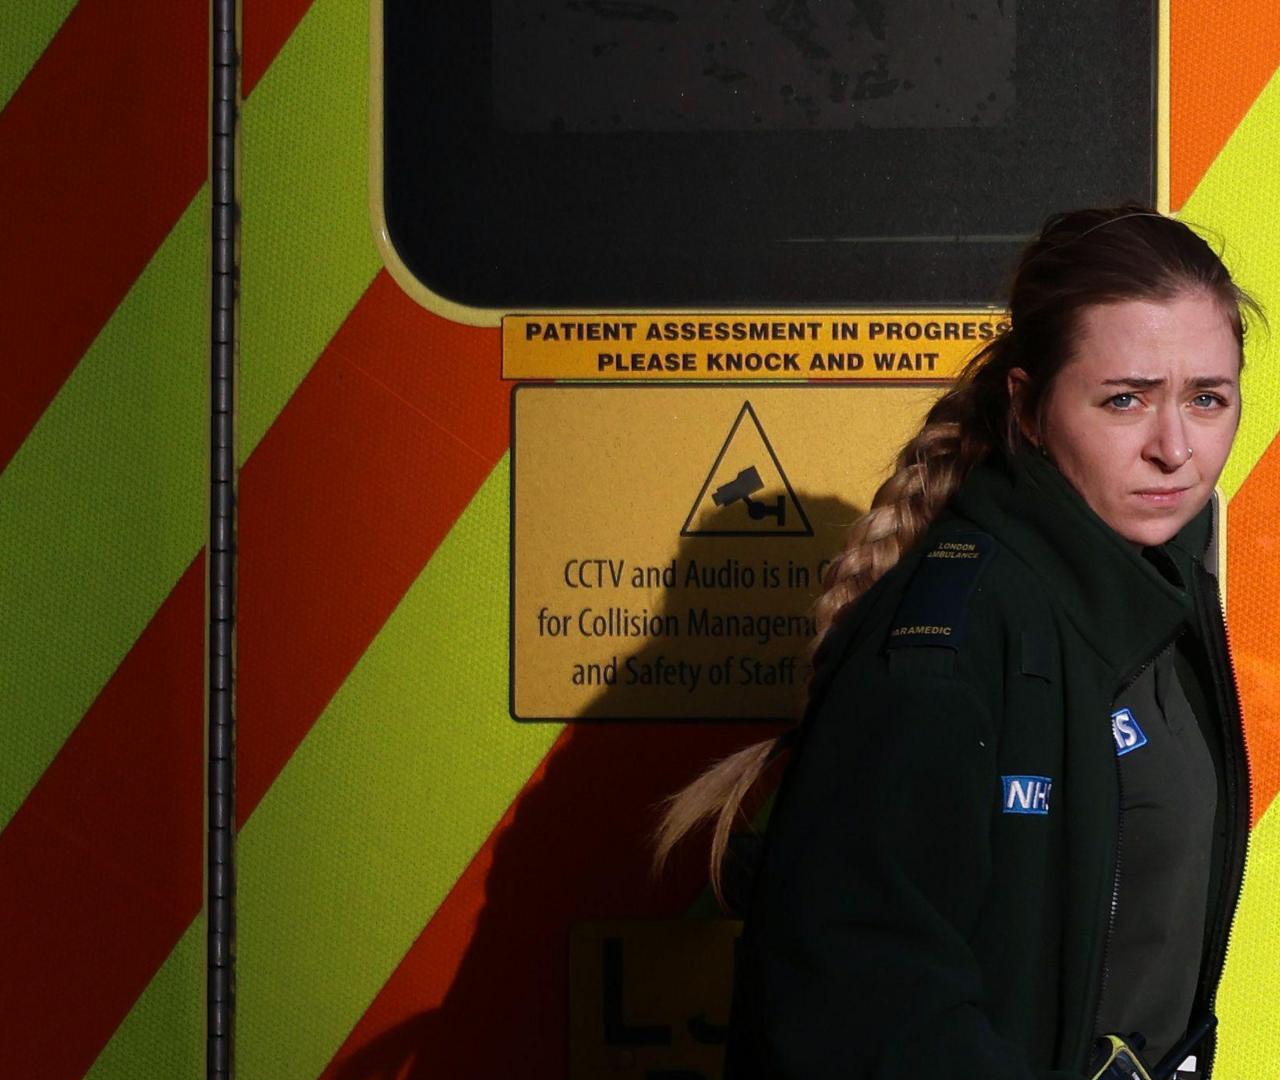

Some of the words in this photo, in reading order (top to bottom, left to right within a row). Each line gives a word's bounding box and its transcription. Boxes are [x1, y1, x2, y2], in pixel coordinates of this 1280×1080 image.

[525, 322, 638, 341] PATIENT
[645, 322, 823, 341] ASSESSMENT
[831, 322, 858, 341] IN
[868, 322, 1009, 341] PROGRESS
[597, 352, 697, 372] PLEASE
[706, 352, 801, 372] KNOCK
[809, 352, 864, 372] AND
[873, 352, 939, 372] WAIT
[938, 542, 977, 551] LONDON
[563, 559, 625, 588] CCTV
[631, 559, 677, 588] and
[685, 559, 755, 588] Audio
[762, 560, 780, 588] is
[788, 560, 810, 588] in
[537, 607, 572, 637] for
[578, 607, 680, 638] Collision
[891, 626, 952, 636] ARAMEDIC
[572, 655, 617, 686] and
[624, 655, 702, 693] Safety
[708, 655, 735, 686] of
[739, 655, 799, 686] Staff
[1006, 780, 1053, 811] NH
